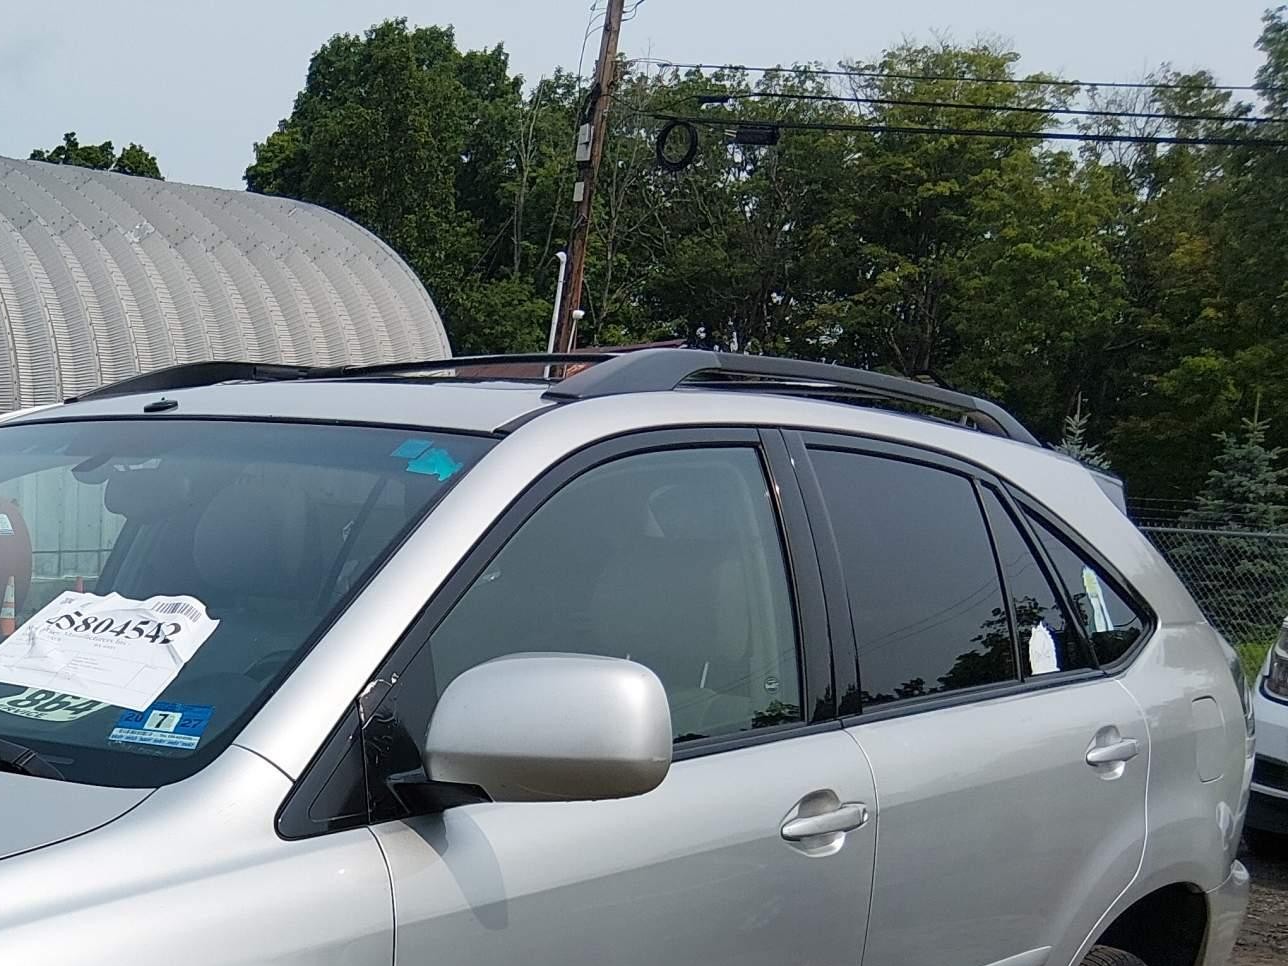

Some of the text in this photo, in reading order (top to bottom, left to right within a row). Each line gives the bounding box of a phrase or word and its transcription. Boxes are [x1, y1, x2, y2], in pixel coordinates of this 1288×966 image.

[124, 712, 204, 729] 20 7 27
